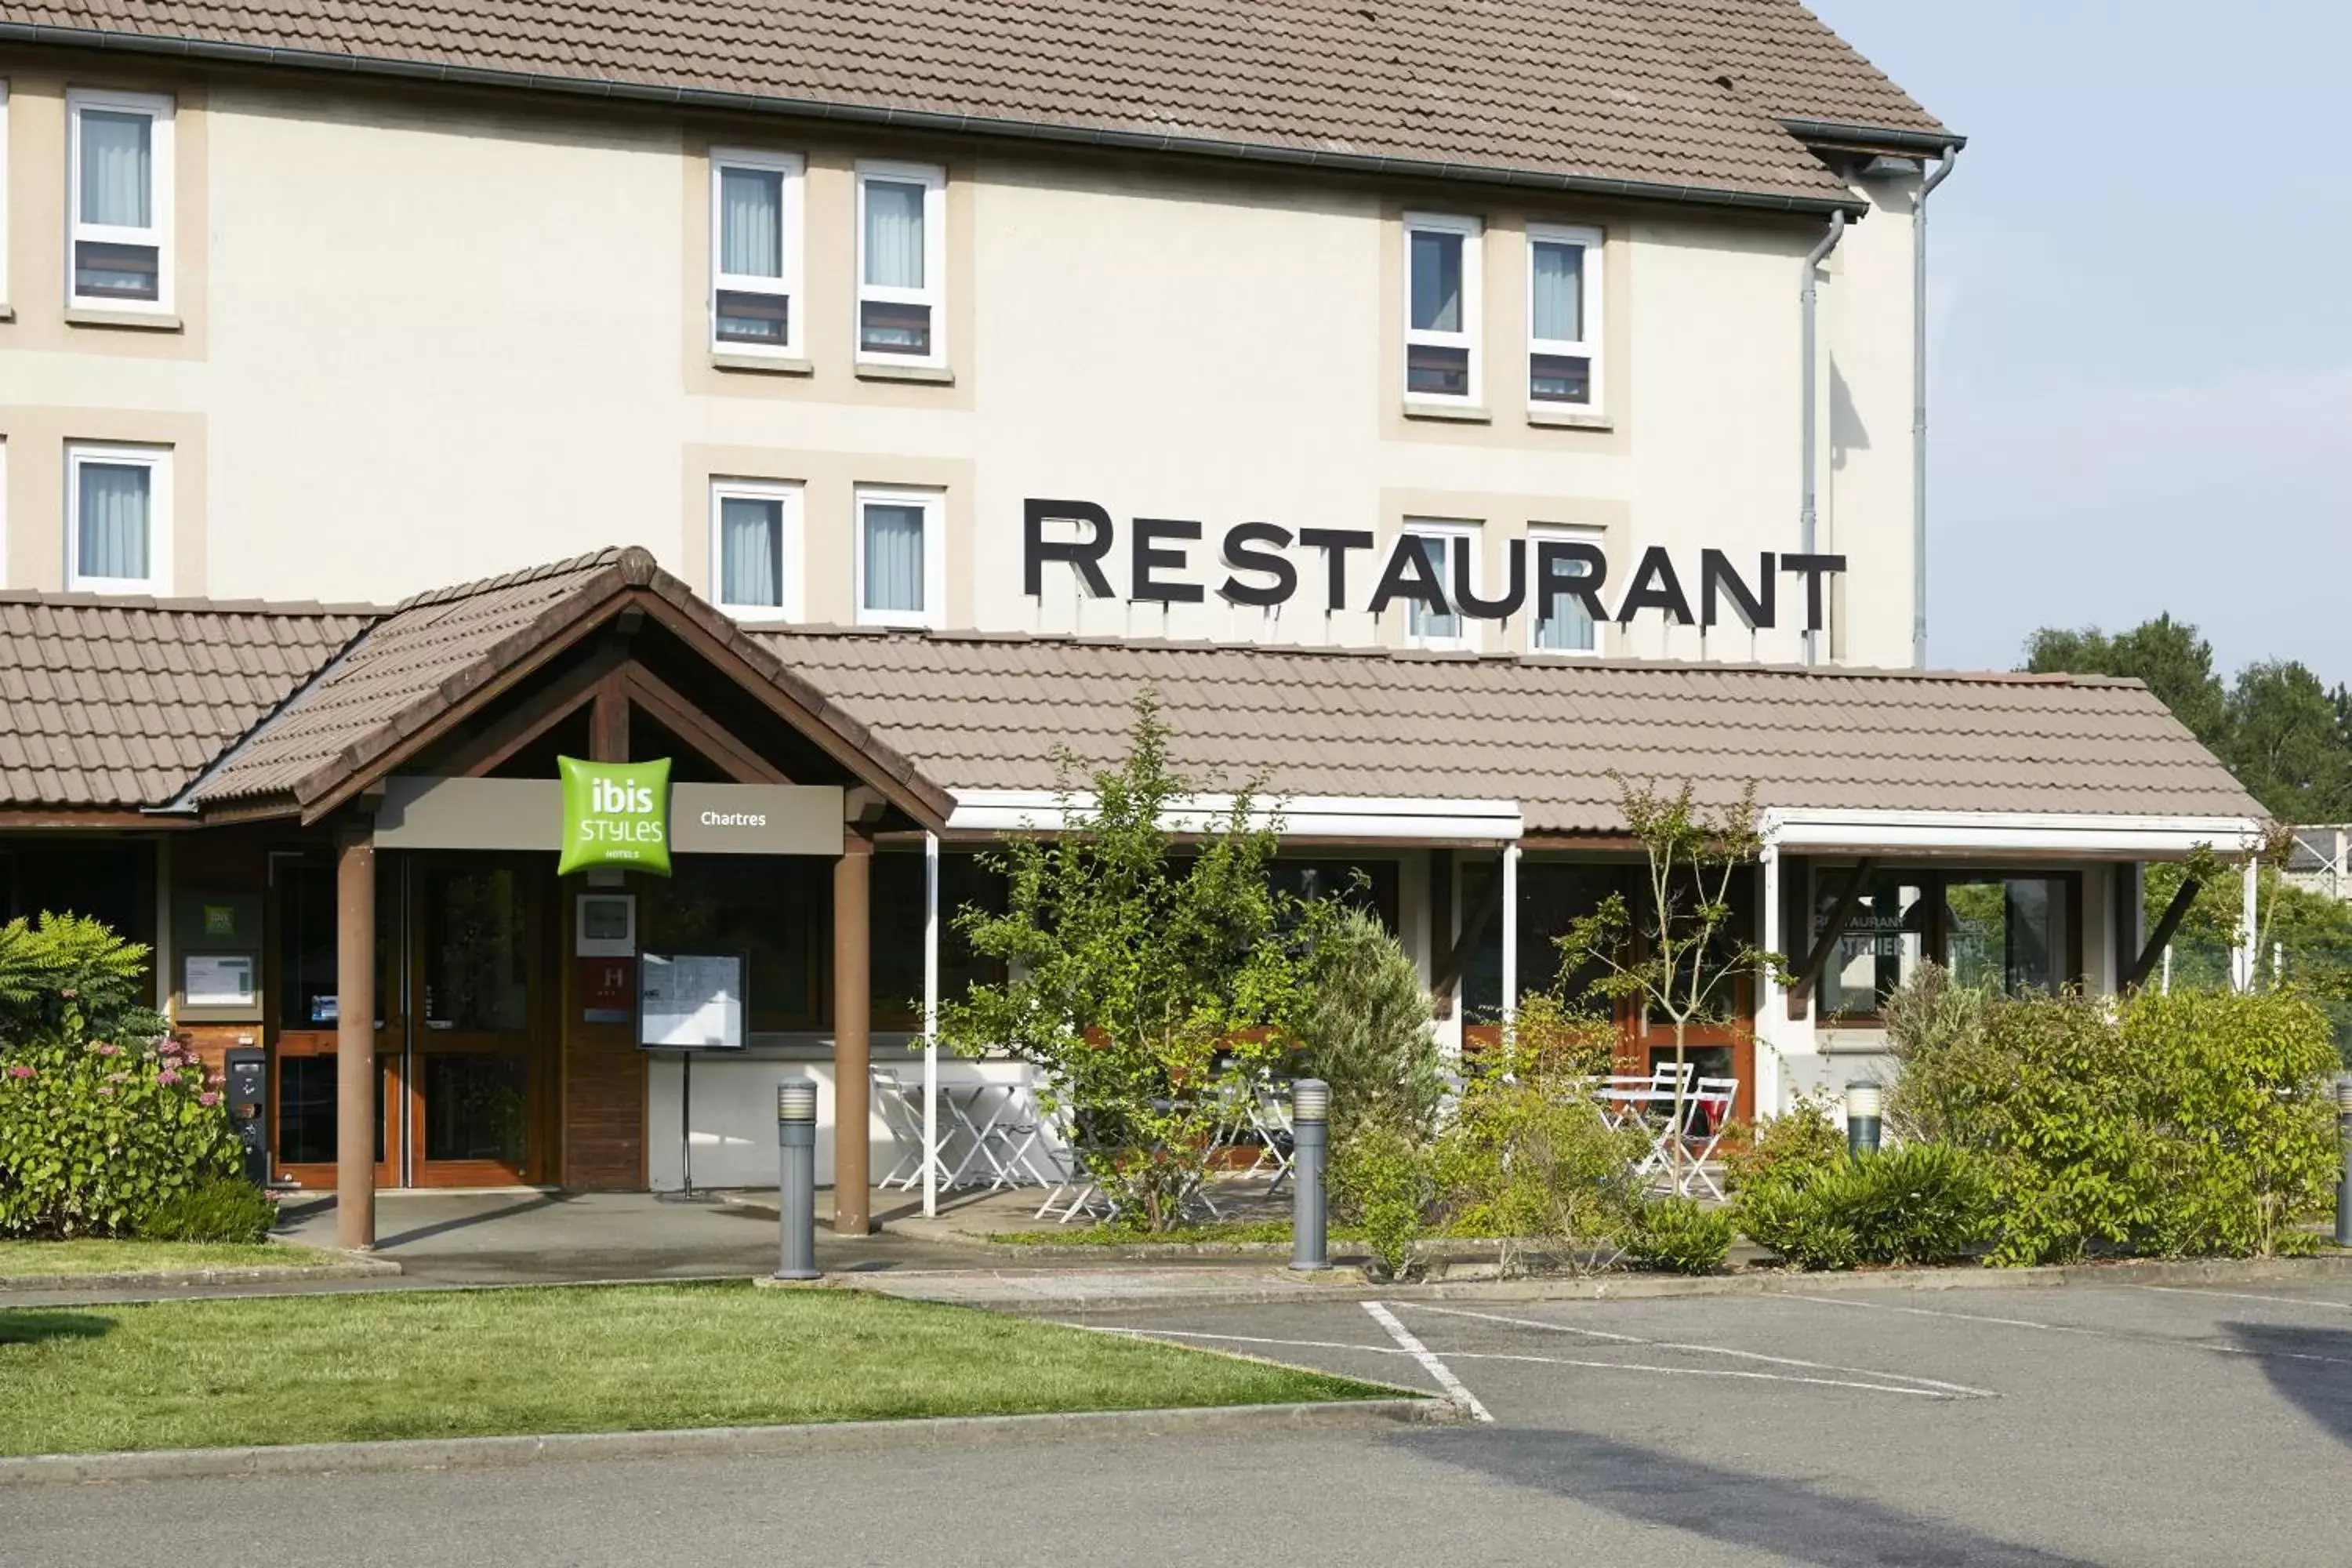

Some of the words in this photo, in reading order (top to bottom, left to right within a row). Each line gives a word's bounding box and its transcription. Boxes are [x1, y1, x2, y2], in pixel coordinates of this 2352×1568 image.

[1024, 498, 1846, 631] RESTAURANT
[593, 778, 653, 814] ibis
[701, 811, 766, 826] Chartres
